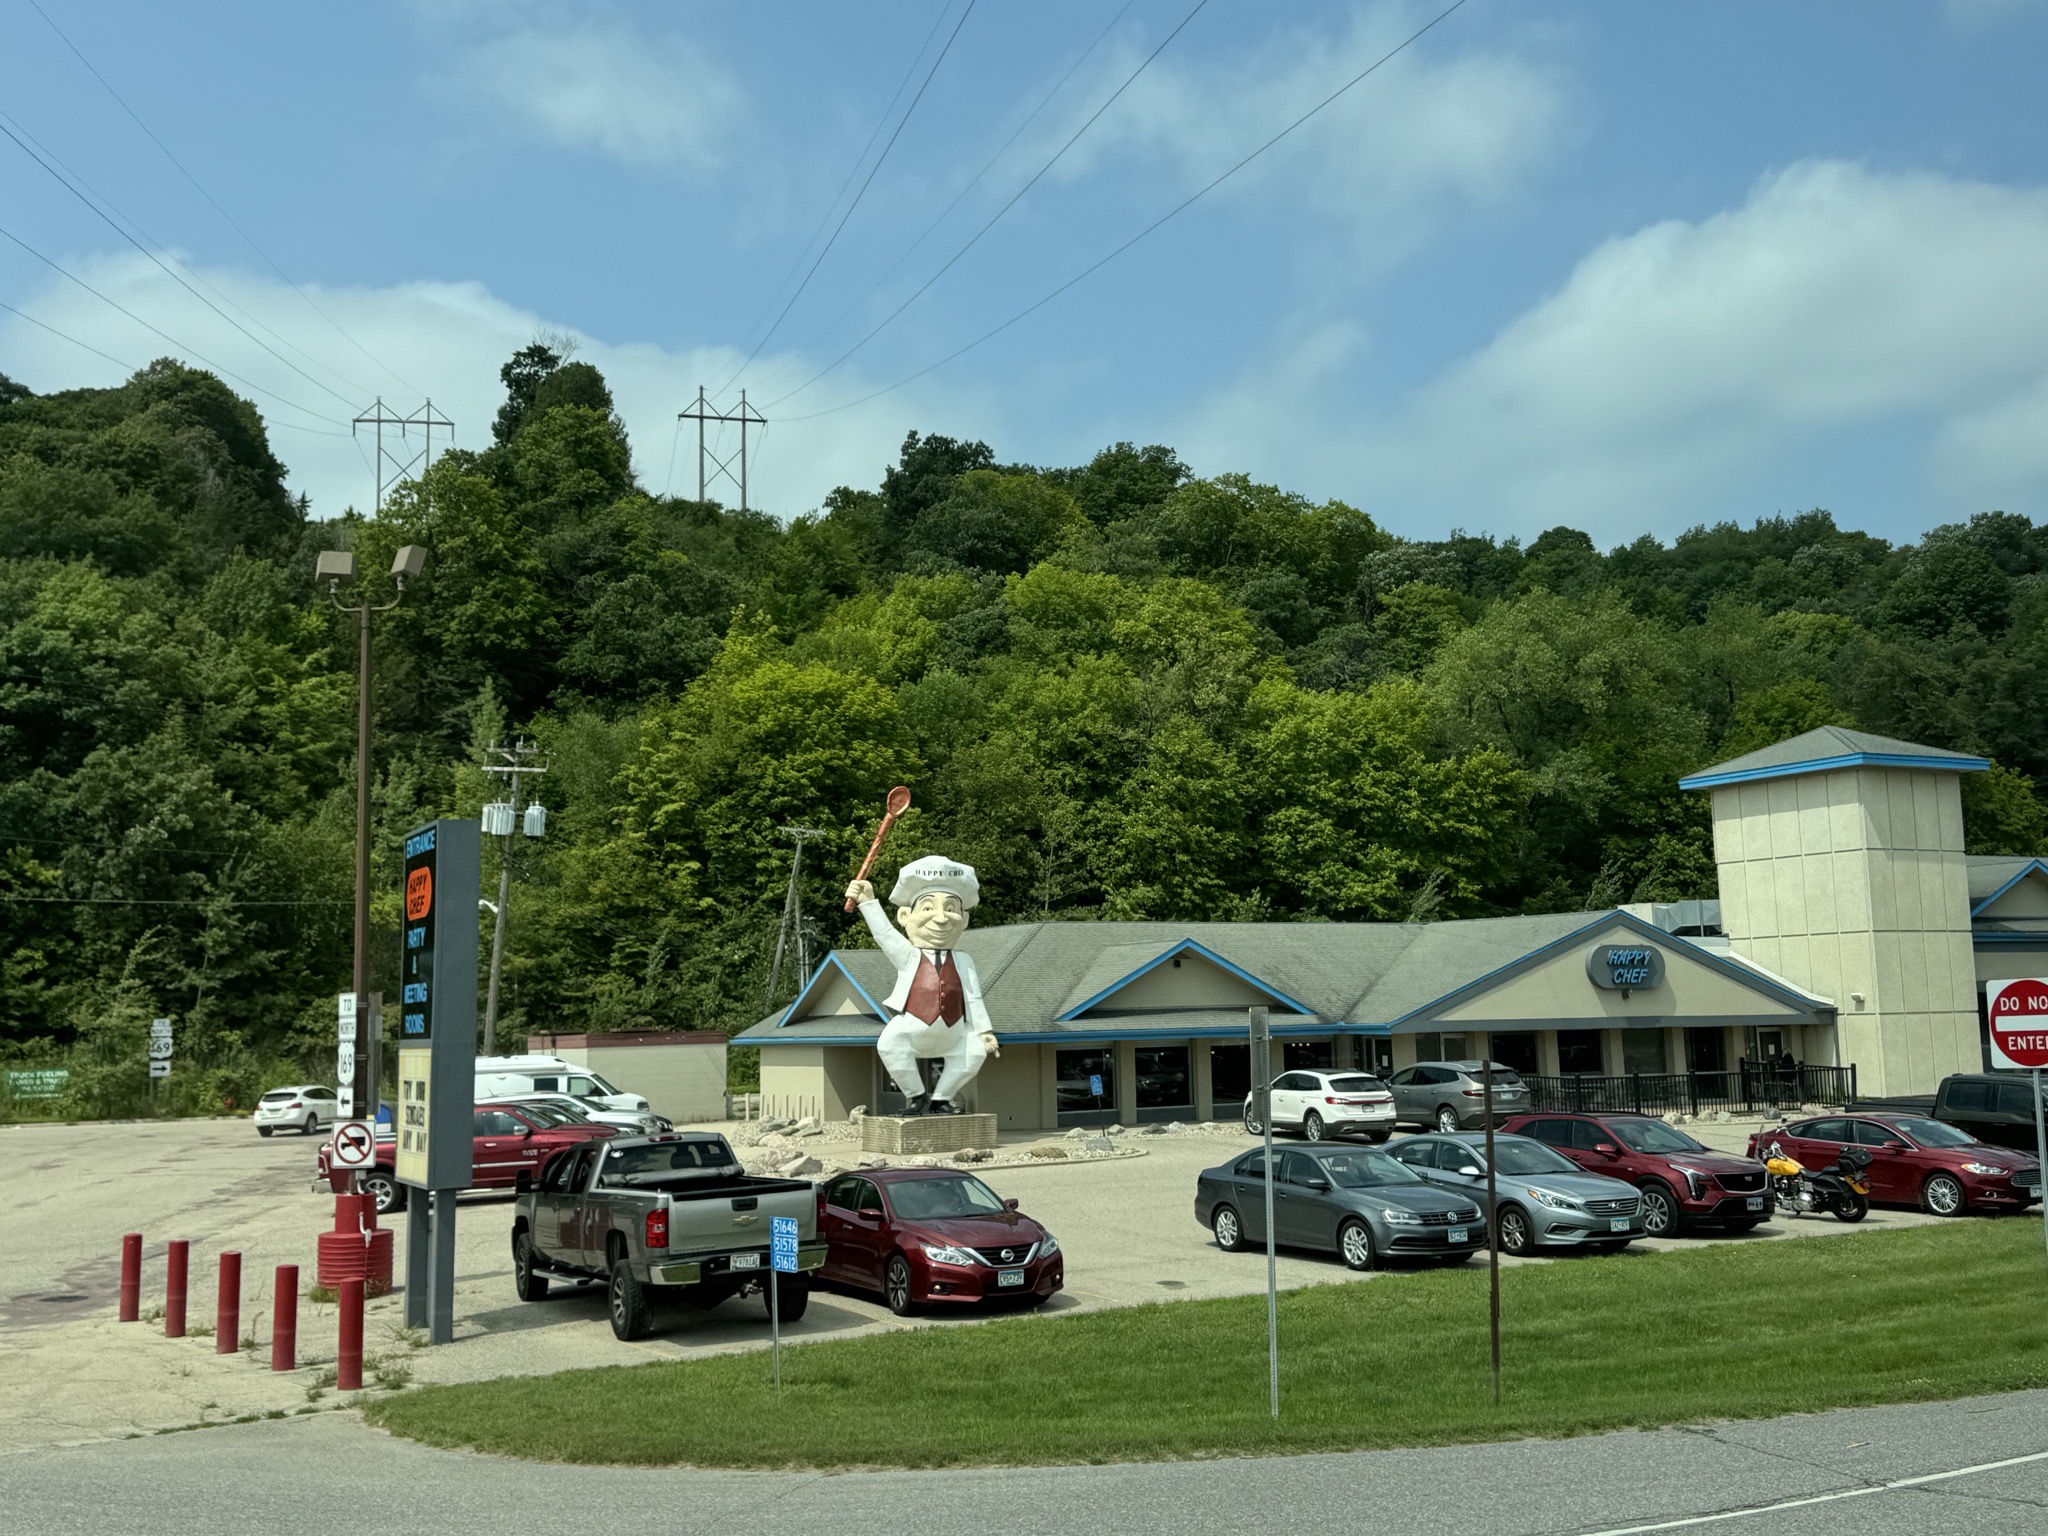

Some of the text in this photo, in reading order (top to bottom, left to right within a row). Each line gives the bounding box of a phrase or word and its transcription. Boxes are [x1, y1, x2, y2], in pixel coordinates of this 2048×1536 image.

[915, 869, 943, 877] HAPPY
[409, 874, 428, 895] HAPPY
[409, 894, 425, 915] CHEF
[1608, 950, 1652, 966] HAPPY
[1613, 968, 1648, 984] CHEF
[343, 999, 352, 1012] TO
[2000, 995, 2048, 1011] DO NO
[340, 1021, 355, 1035] NORTH
[340, 1053, 353, 1074] 169
[774, 1219, 798, 1235] 51646
[774, 1236, 798, 1253] 51578
[776, 1255, 797, 1271] 51612
